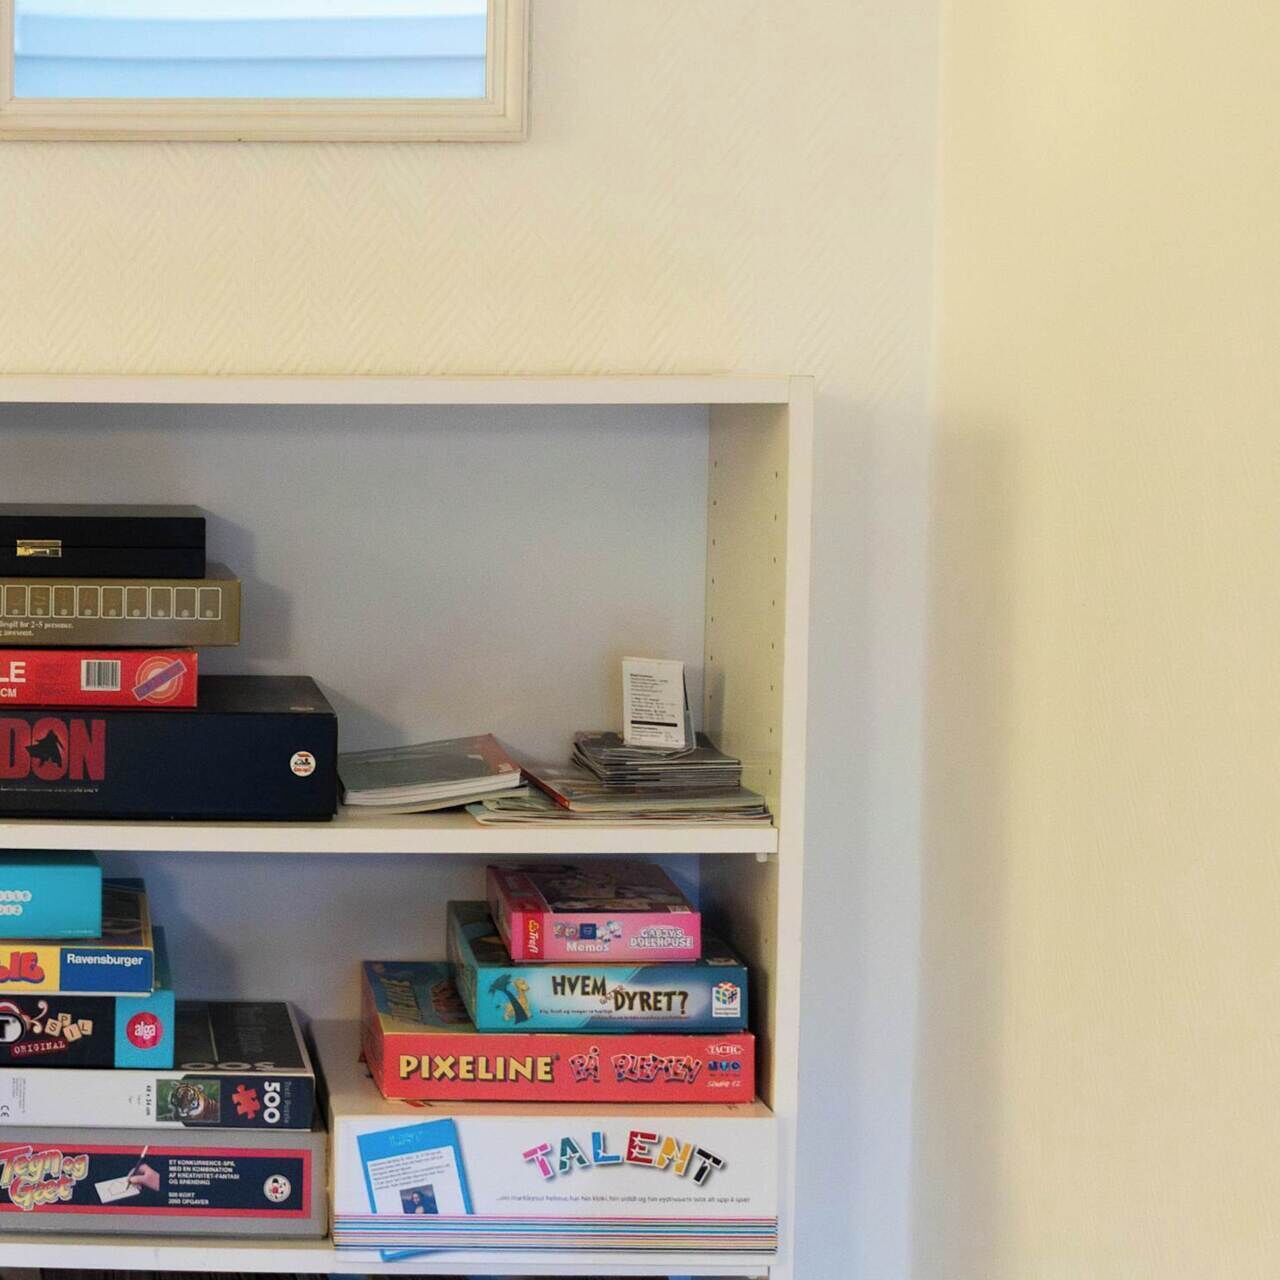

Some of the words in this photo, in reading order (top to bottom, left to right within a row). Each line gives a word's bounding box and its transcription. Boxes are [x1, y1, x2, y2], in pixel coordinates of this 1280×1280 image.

[66, 953, 144, 967] Ravensburger
[551, 974, 607, 997] HVEM
[613, 990, 689, 1015] DYRET?
[134, 1021, 157, 1040] alga
[13, 1040, 66, 1055] ORIGINAL
[399, 1054, 554, 1083] PIXELINE
[263, 1080, 281, 1124] 500
[521, 1130, 726, 1186] TALENT
